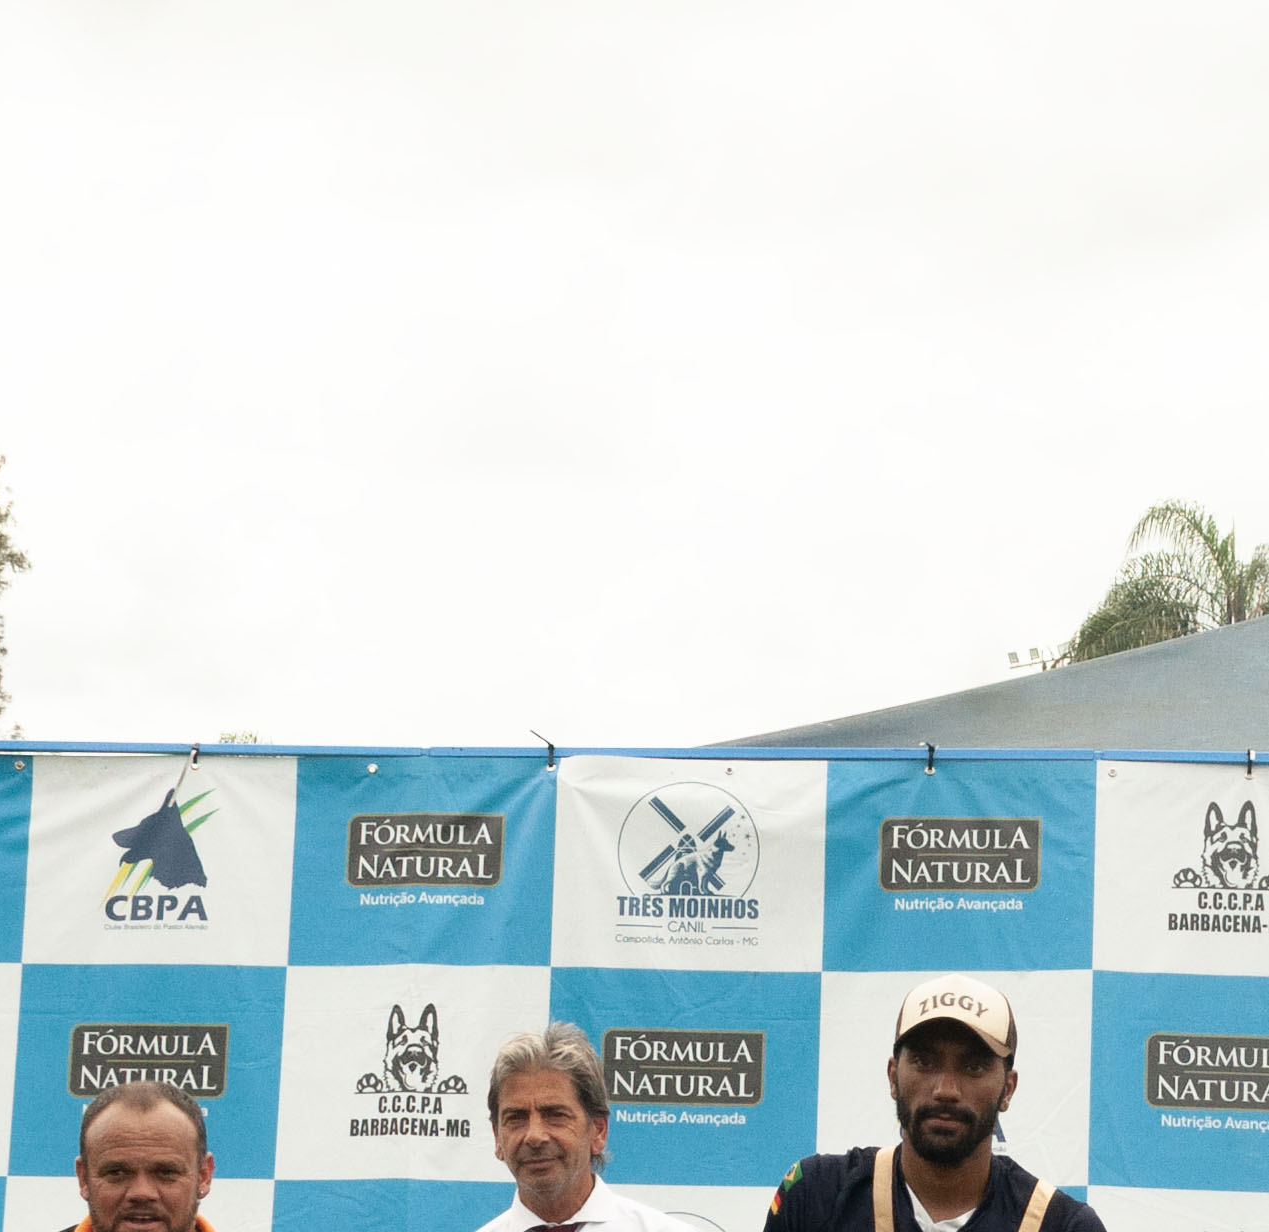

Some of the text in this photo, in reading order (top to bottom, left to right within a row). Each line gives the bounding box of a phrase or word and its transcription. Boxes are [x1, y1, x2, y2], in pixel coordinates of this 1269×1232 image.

[359, 819, 493, 845] FÓRMULA
[891, 823, 1031, 849] FÓRMULA
[357, 854, 493, 879] NATURAL
[890, 858, 1031, 883] NATURAL
[105, 895, 208, 921] CBPA
[360, 892, 484, 907] Nutrição Avançada
[617, 893, 759, 919] TRÊS MOINHOS
[894, 897, 1023, 912] Nutrição Avançada
[1198, 891, 1264, 911] C.C.C.P.A
[667, 920, 707, 933] CANIL
[1168, 913, 1269, 933] BARBACENA-
[742, 937, 758, 946] MG
[919, 992, 989, 1018] ZIGGY
[82, 1029, 218, 1056] FÓRMULA
[614, 1034, 754, 1063] FÓRMULA
[1158, 1039, 1269, 1068] FÓRMUL
[612, 1070, 754, 1097] NATURAL
[1156, 1074, 1269, 1103] NATUR
[378, 1095, 443, 1114] C.C.C.P.A
[350, 1117, 470, 1138] BARBACENA-MG
[616, 1110, 746, 1126] Nutrição Avançada
[1161, 1114, 1221, 1131] Nutrição
